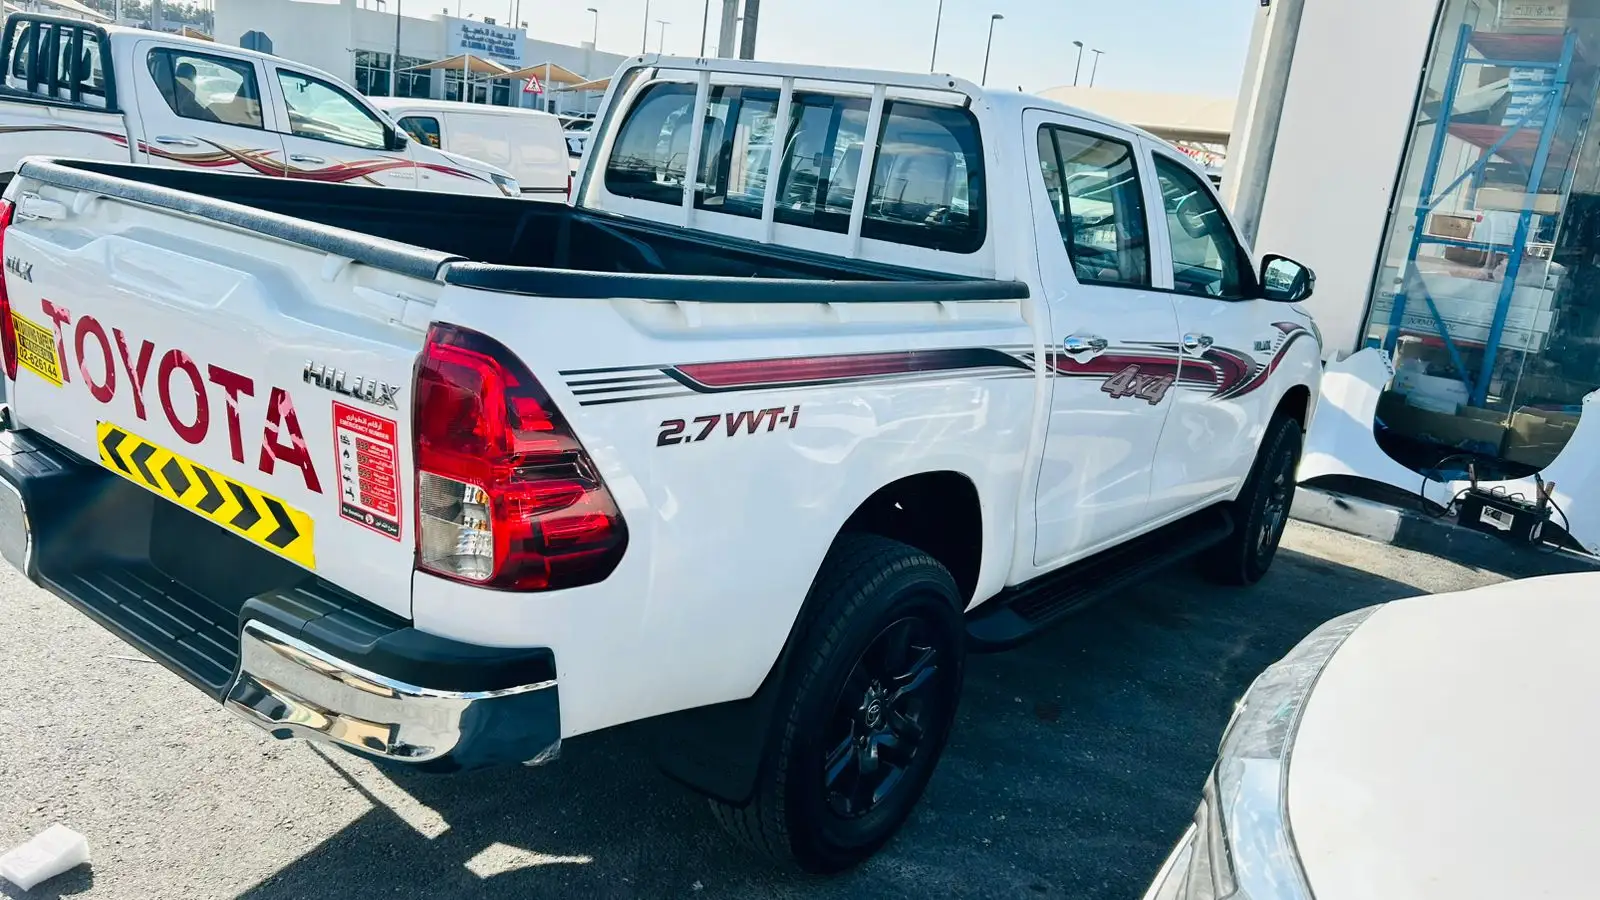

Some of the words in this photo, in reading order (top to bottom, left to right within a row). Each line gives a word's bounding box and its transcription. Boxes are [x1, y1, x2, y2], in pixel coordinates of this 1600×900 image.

[41, 298, 323, 495] TOYOTA
[302, 359, 401, 410] HILUX
[656, 414, 721, 447] 2.7
[725, 405, 800, 438] VVT-i
